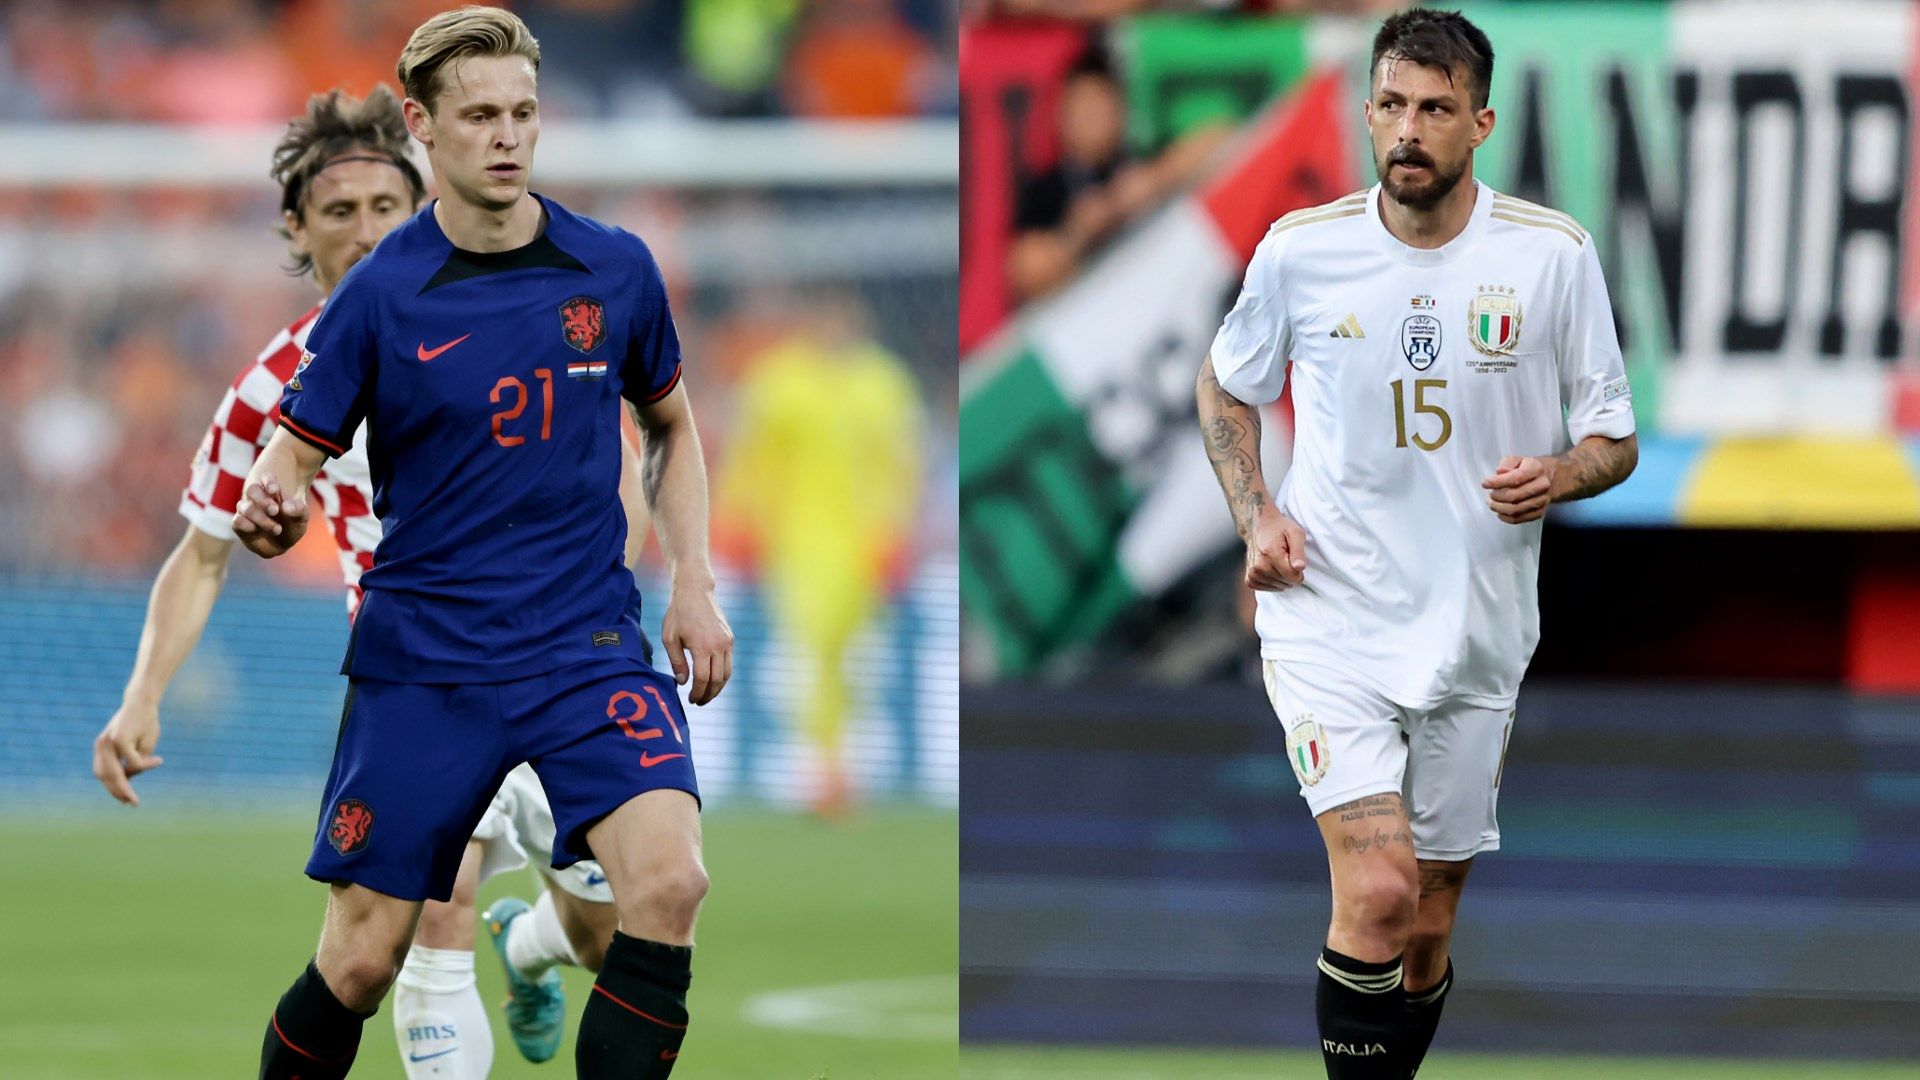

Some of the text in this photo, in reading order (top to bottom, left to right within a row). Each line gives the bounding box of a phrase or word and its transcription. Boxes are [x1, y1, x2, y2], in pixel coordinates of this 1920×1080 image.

[489, 368, 553, 447] 21
[1390, 379, 1452, 451] 15
[606, 685, 683, 744] 21
[1323, 1038, 1387, 1056] ITALIA
